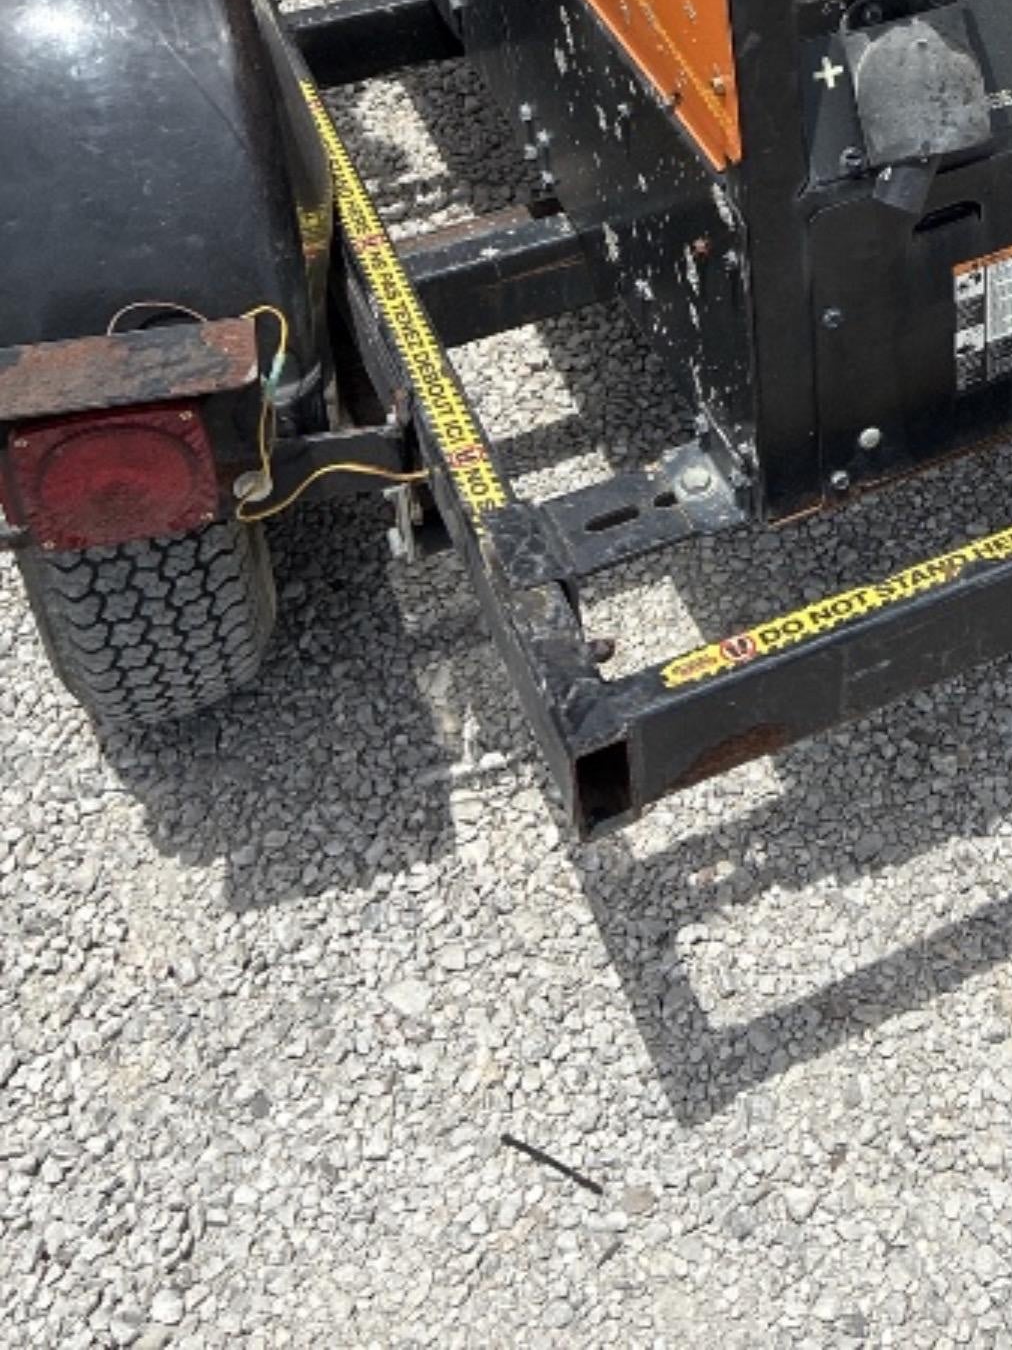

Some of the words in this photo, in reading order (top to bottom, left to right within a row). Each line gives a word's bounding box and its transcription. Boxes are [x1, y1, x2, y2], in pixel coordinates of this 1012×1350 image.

[413, 351, 455, 416] DEBOUT
[759, 620, 804, 645] DO
[810, 591, 868, 623] NOT
[875, 554, 967, 598] STAND
